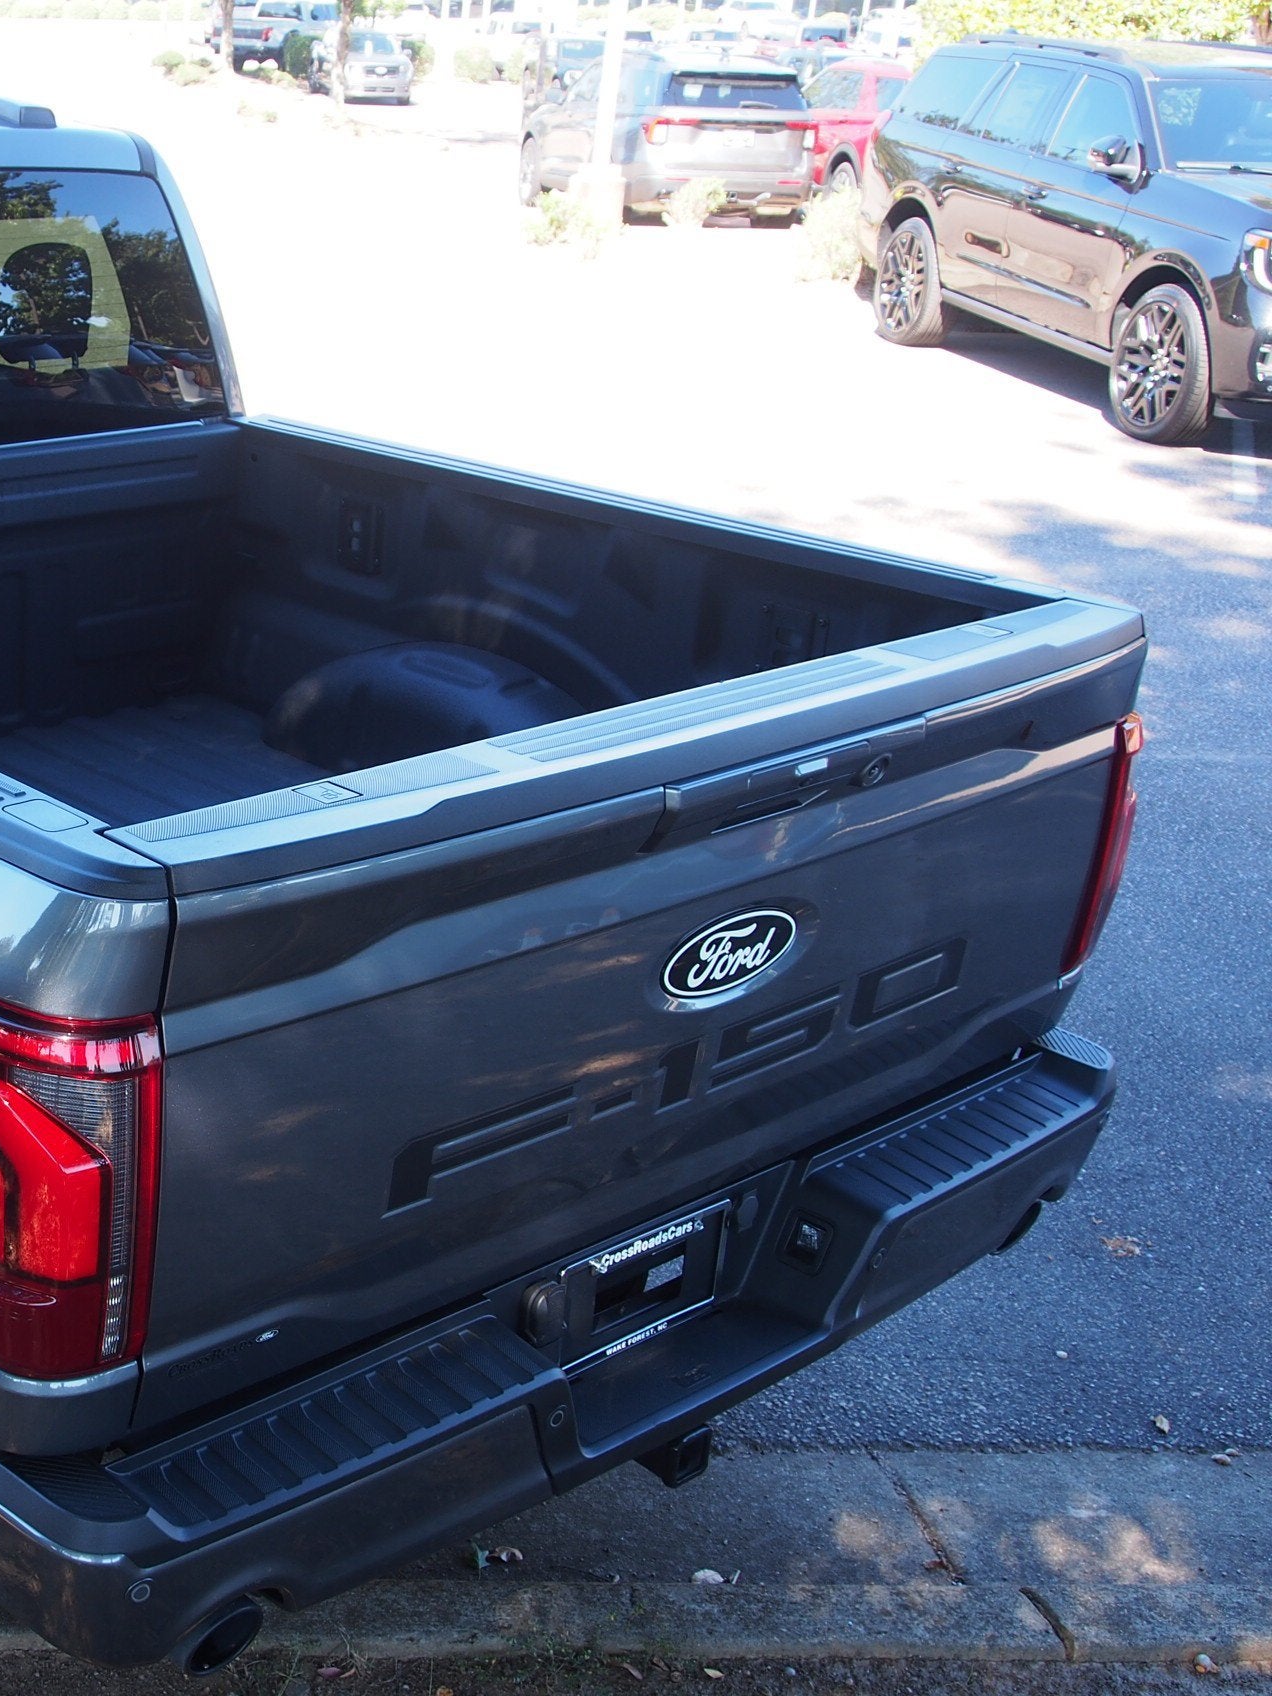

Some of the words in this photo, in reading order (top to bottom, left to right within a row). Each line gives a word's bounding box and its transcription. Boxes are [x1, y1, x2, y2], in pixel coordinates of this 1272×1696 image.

[687, 923, 776, 988] Ford
[381, 937, 968, 1219] F-150
[601, 1221, 694, 1266] CrossRoadsCars
[606, 1341, 627, 1356] WAKE
[628, 1329, 657, 1346] FOREST,
[657, 1322, 668, 1332] NC
